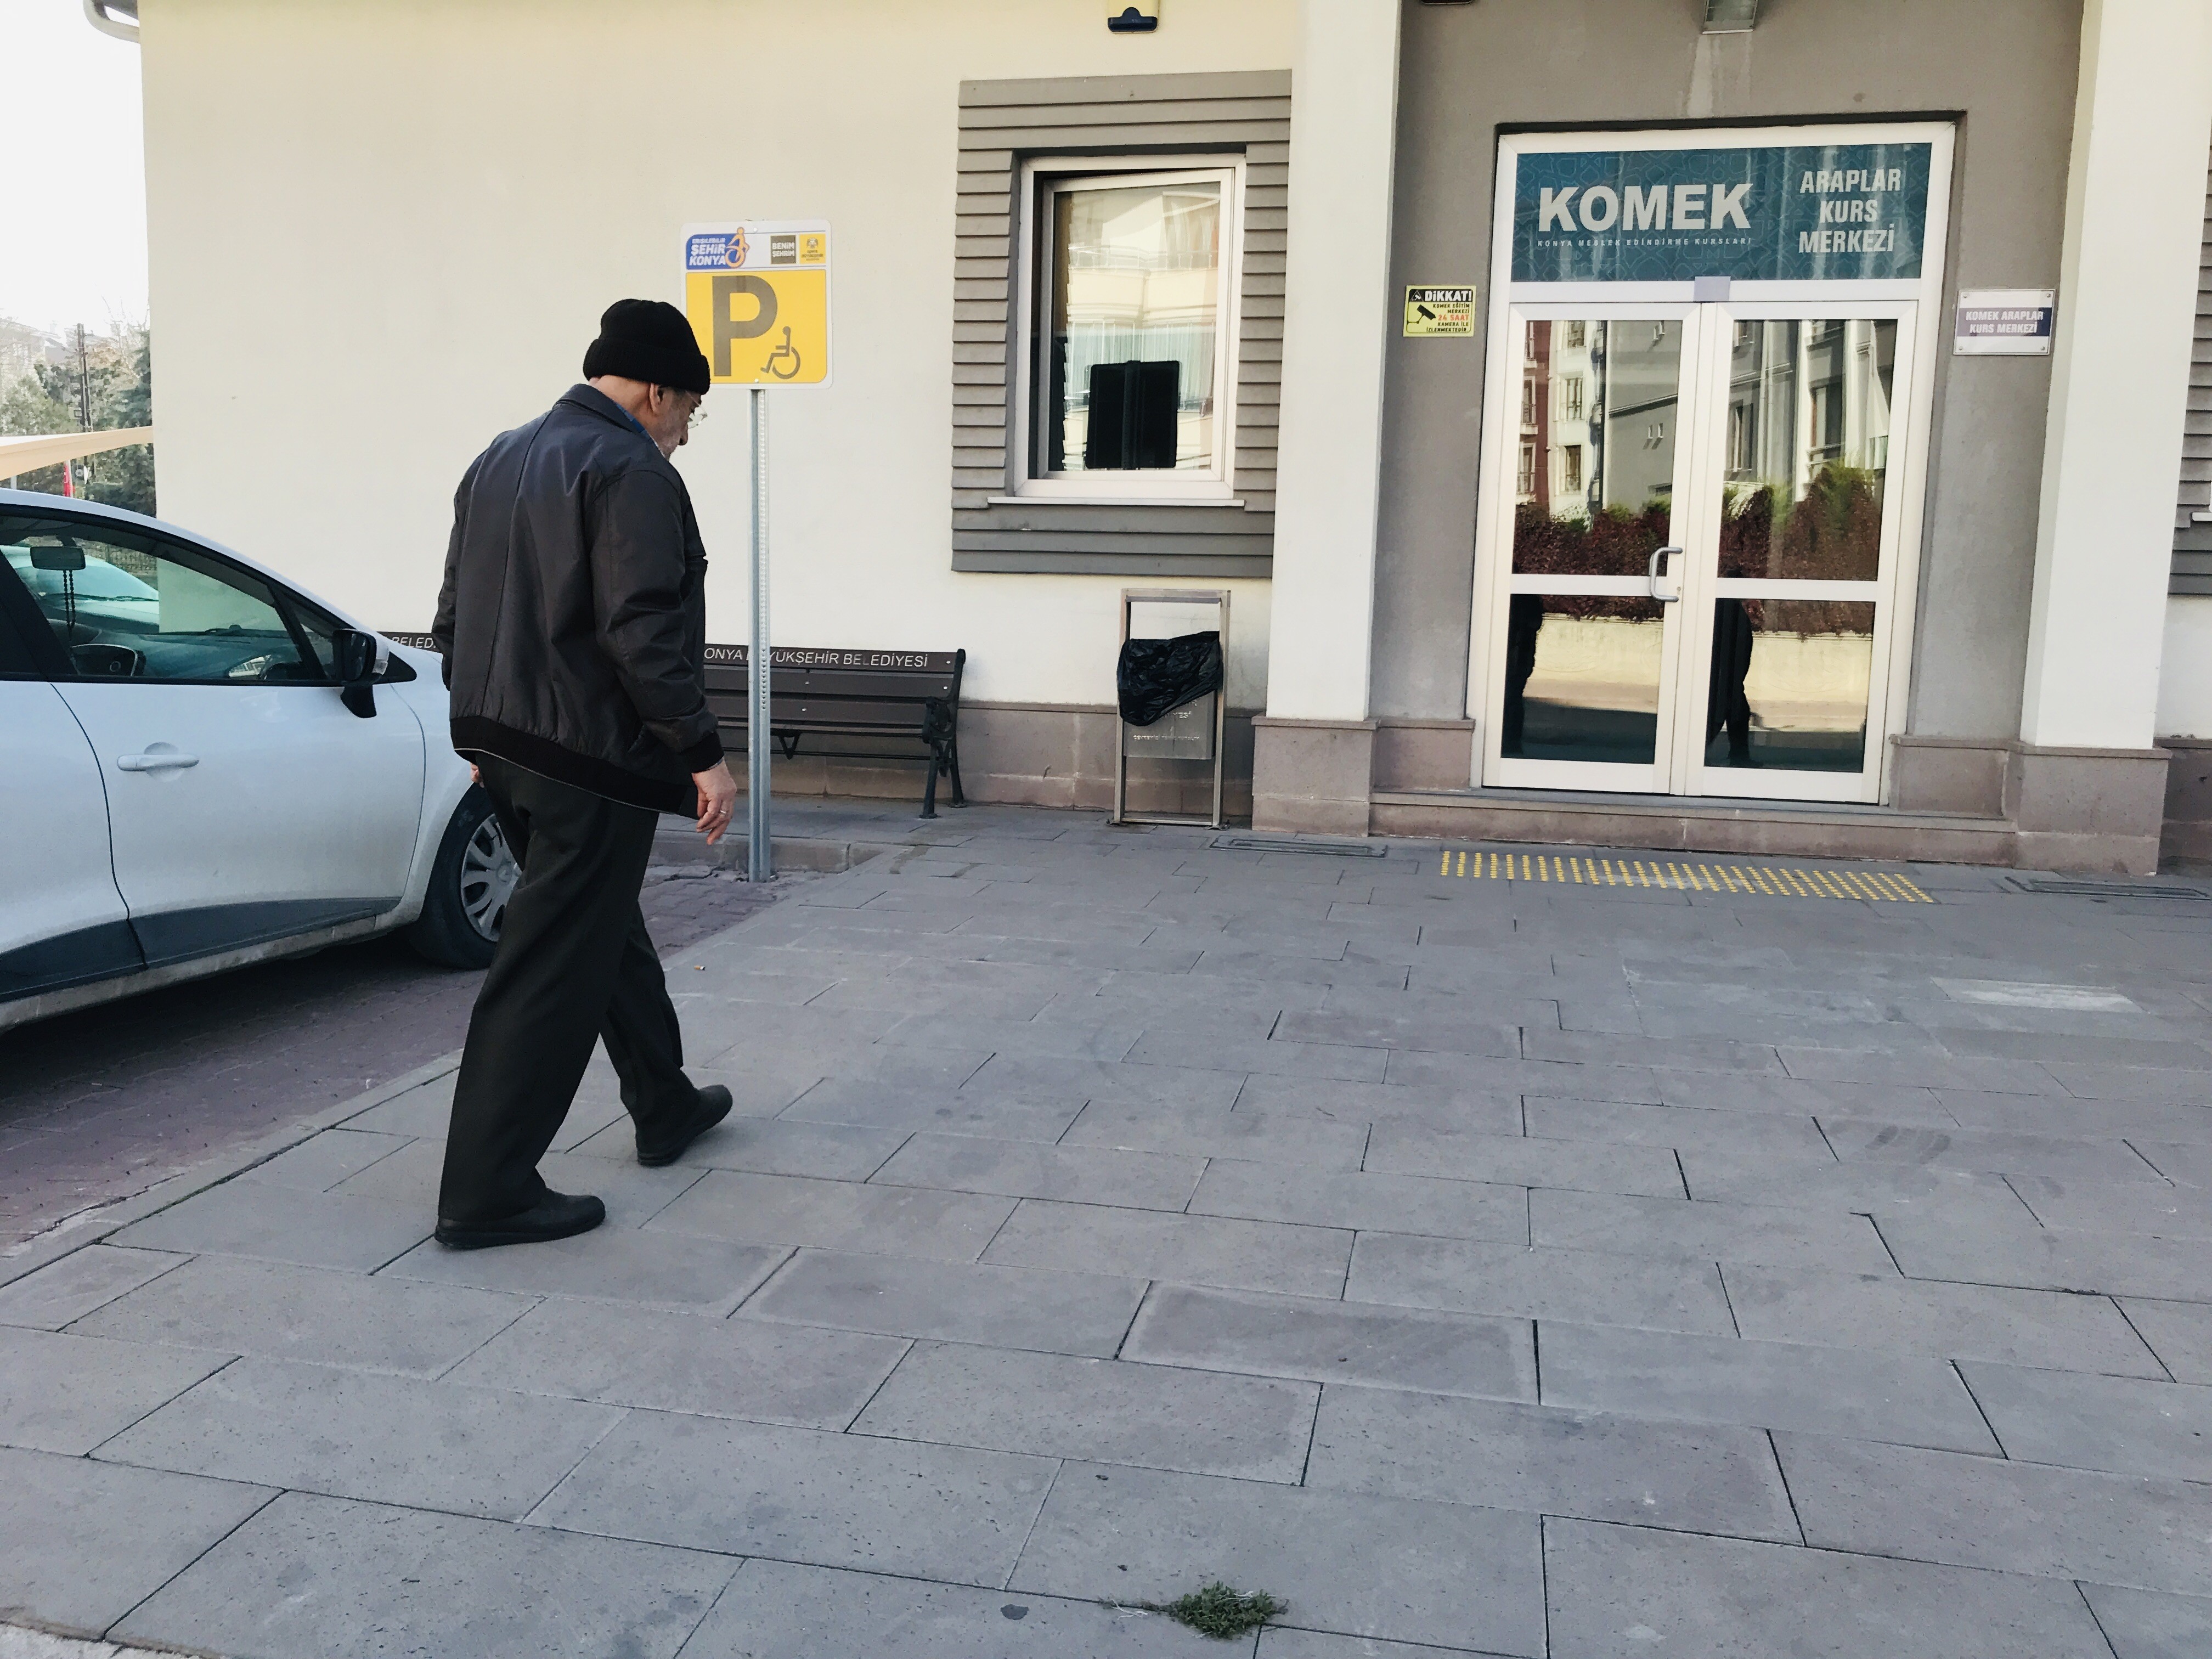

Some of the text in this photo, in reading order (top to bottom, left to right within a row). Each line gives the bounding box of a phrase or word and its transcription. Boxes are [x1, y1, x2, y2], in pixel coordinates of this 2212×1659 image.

[1800, 168, 1901, 193] ARAPLAR
[1538, 183, 1753, 232] KOMEK
[1820, 199, 1878, 223] KURS
[1799, 223, 1895, 253] MERKEZİ
[690, 244, 726, 256] ŞEHİR
[689, 256, 726, 266] KONYA
[1966, 311, 2044, 320] KOMEK ARAPLAR
[712, 275, 777, 376] P
[1970, 322, 2038, 333] KURS MERKEZİ
[704, 647, 743, 661] ONYA
